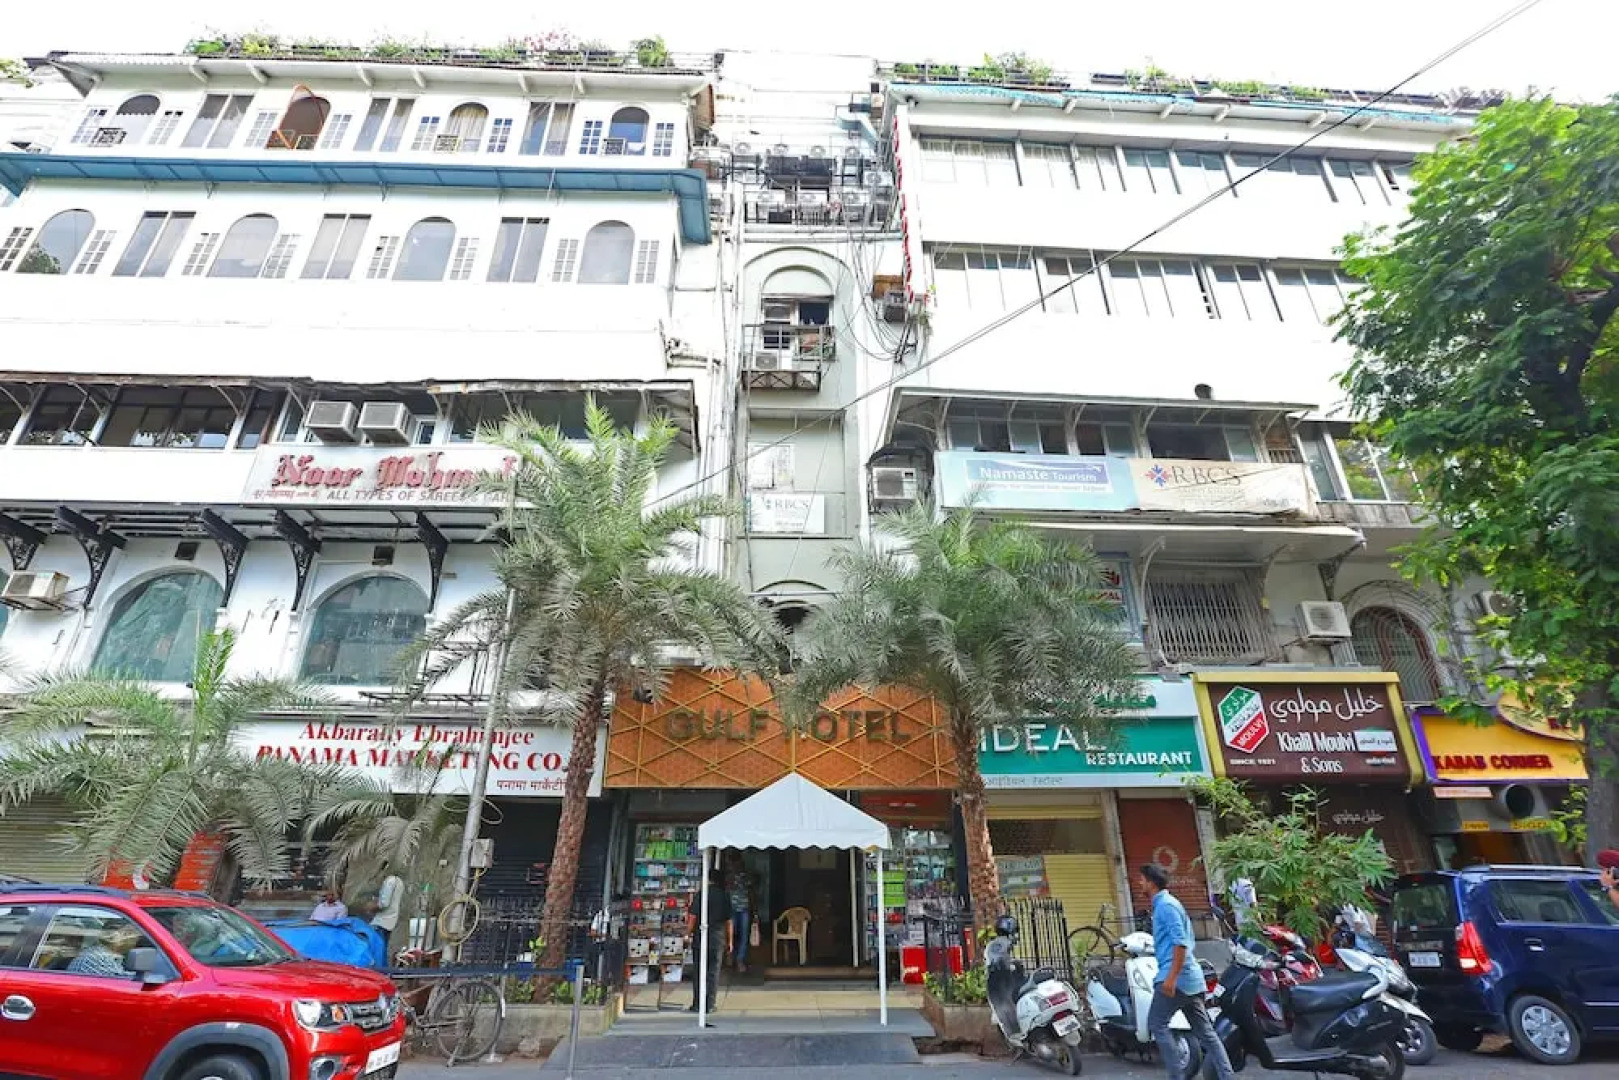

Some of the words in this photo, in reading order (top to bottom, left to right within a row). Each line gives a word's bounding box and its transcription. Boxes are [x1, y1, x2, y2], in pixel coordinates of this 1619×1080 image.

[272, 455, 363, 487] Noor
[980, 468, 1048, 480] Namaste
[1052, 472, 1097, 482] Tourism
[1172, 465, 1241, 486] RBCS
[327, 489, 350, 500] ALL
[355, 489, 395, 500] TYPES
[398, 490, 414, 501] OF
[1335, 687, 1384, 720] خليل
[667, 709, 769, 740] GULF
[784, 708, 912, 741] OTEL
[980, 722, 1107, 753] IDEAL
[256, 745, 358, 767] PANAMA
[1085, 751, 1192, 766] RESTAURANT
[1301, 757, 1312, 773] &
[1312, 757, 1343, 773] Sons
